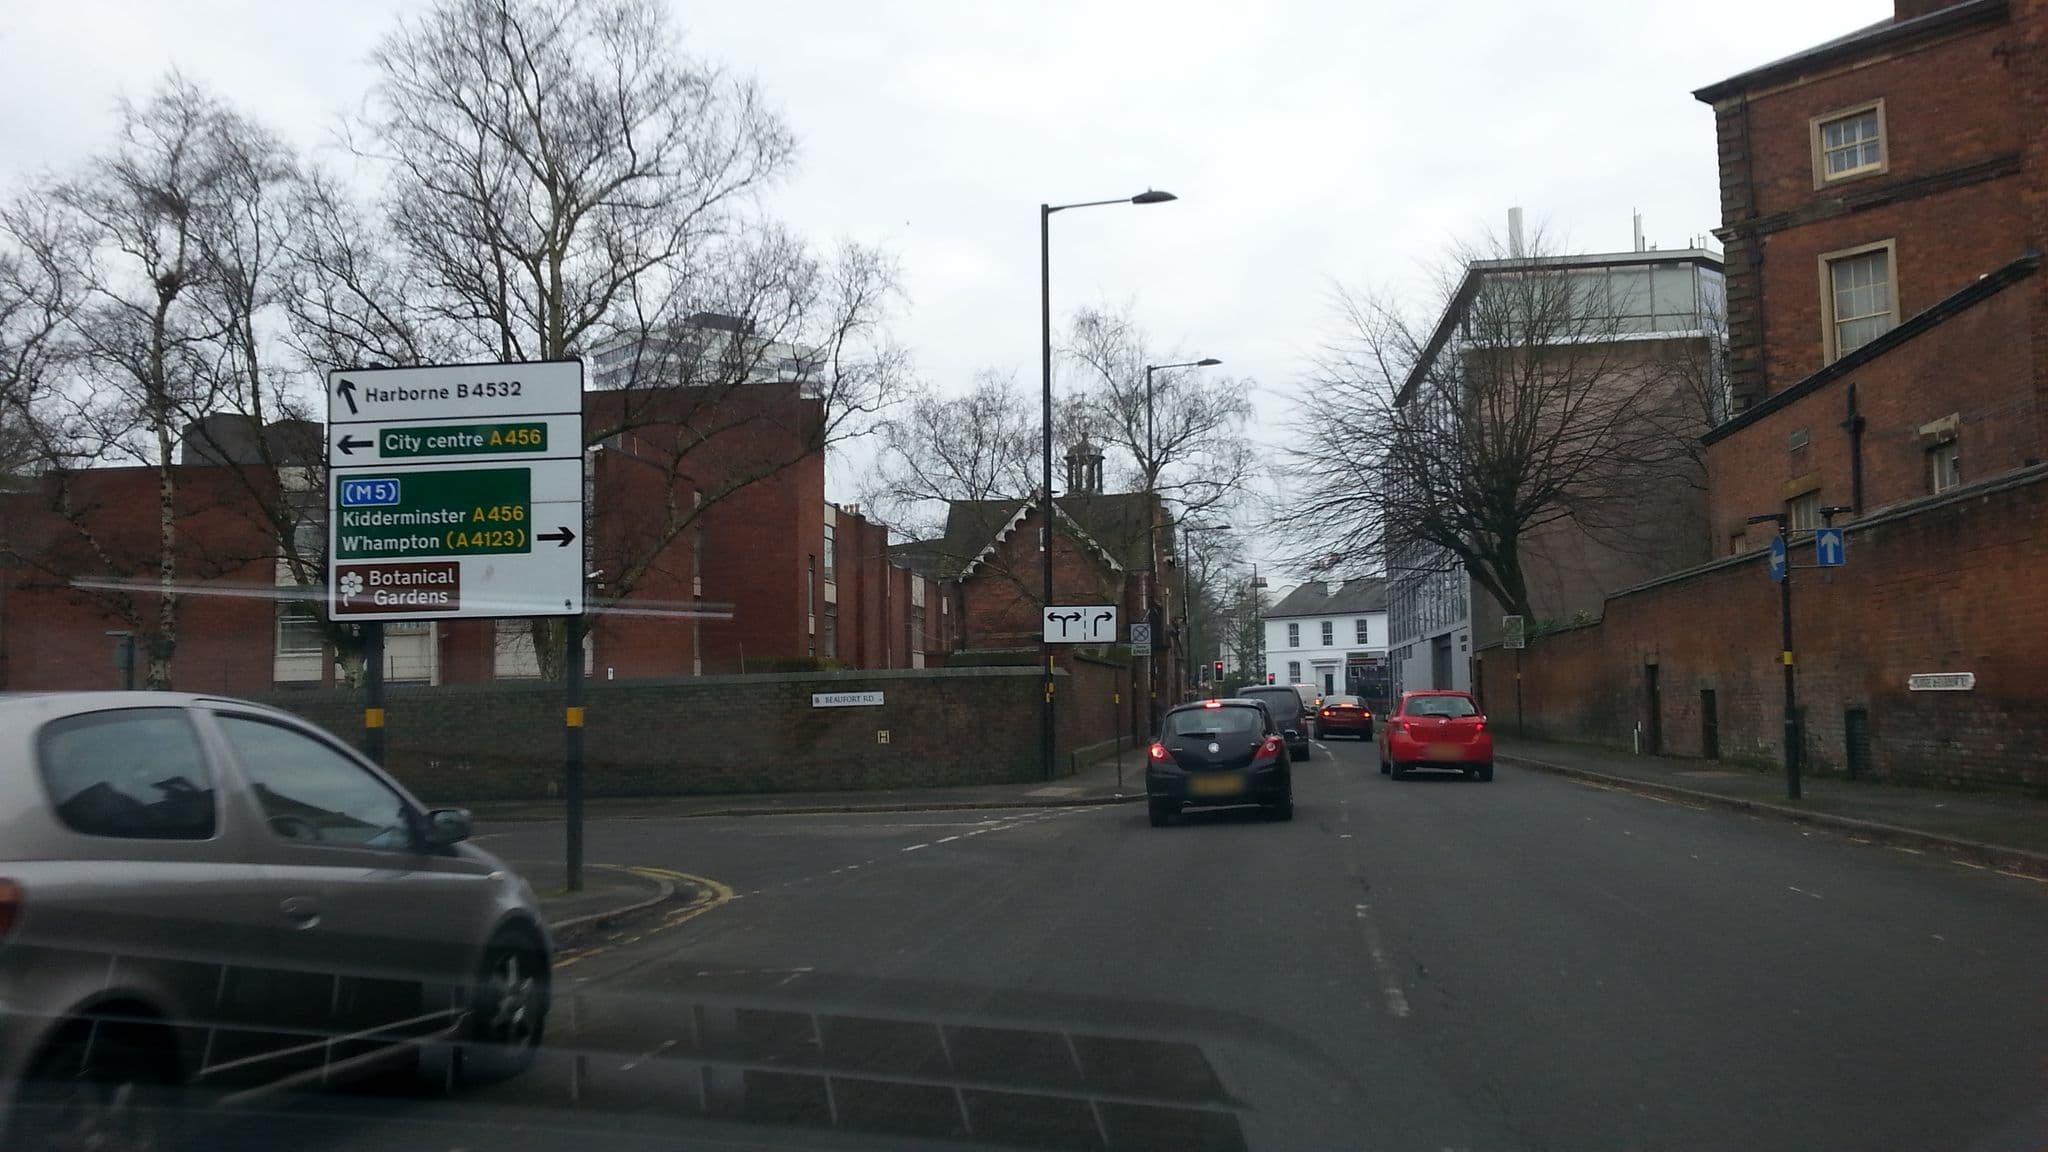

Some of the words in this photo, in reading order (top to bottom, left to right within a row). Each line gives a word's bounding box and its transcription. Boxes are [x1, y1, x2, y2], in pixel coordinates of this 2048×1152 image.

[366, 386, 449, 402] Harborne
[457, 381, 522, 398] B4532
[385, 434, 421, 452] City
[427, 432, 484, 449] centre
[489, 429, 541, 446] A456
[345, 483, 396, 502] (M5)
[343, 508, 466, 527] Kidderminster
[472, 506, 524, 522] A456
[342, 533, 440, 552] W'hampton
[446, 528, 525, 548] (A4123)
[369, 568, 454, 586] Botanical
[374, 588, 448, 606] Gardens
[825, 695, 860, 704] BEAUFORT
[863, 695, 874, 703] RD
